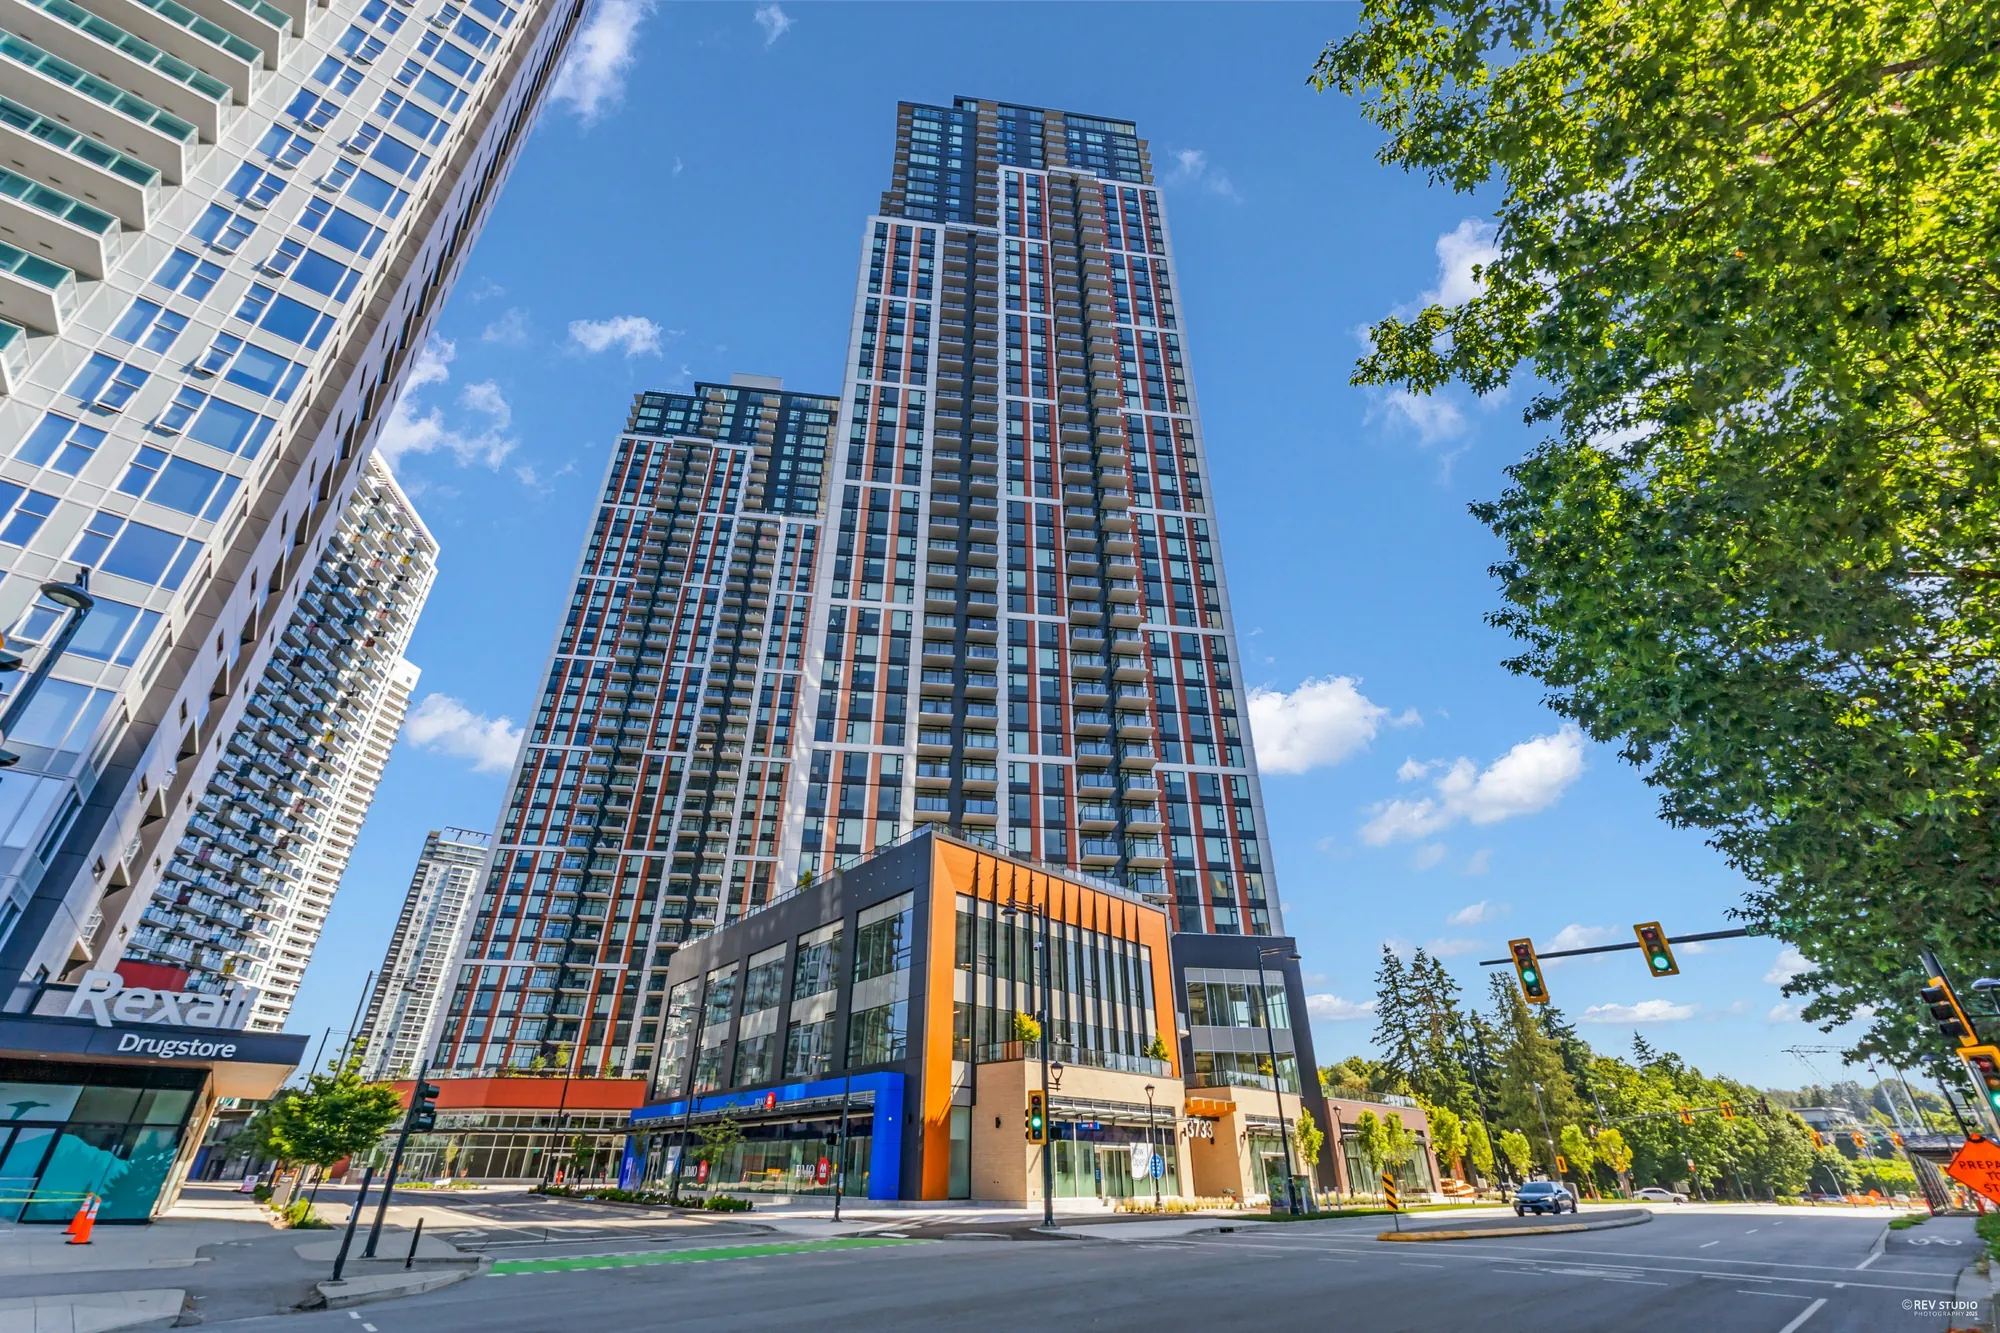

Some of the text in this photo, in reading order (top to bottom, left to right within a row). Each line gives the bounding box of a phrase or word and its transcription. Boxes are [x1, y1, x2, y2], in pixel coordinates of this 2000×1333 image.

[64, 969, 259, 1030] Rexall
[117, 1033, 237, 1058] Drugstore
[1188, 1118, 1213, 1138] 3733
[684, 1165, 698, 1177] BMO
[795, 1164, 816, 1178] BMO
